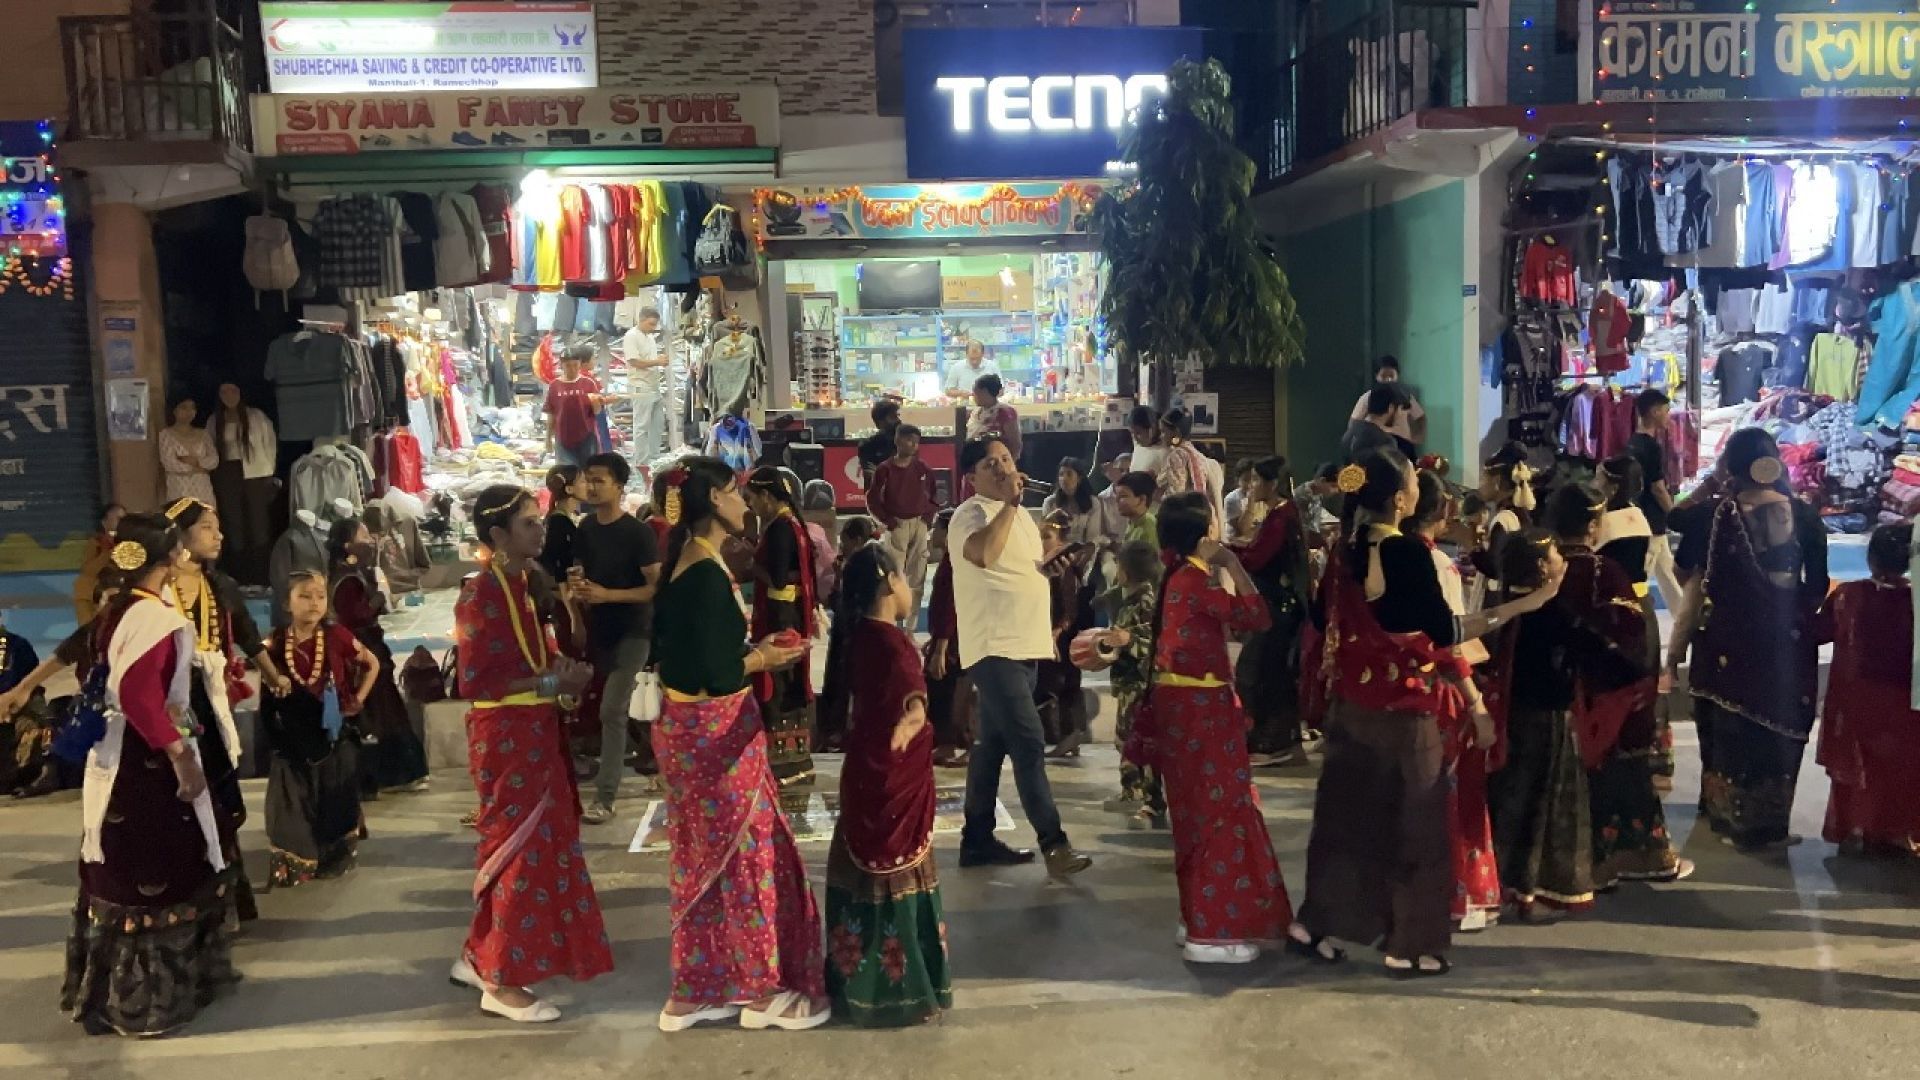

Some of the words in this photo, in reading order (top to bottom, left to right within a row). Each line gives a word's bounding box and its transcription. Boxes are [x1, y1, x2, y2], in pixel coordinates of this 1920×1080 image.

[1599, 13, 1760, 78] कामना
[273, 59, 359, 77] SHUBHECHHA
[362, 58, 408, 75] SAVING
[411, 58, 420, 74] &
[424, 57, 467, 74] CREDIT
[470, 56, 557, 74] CO-OPERATIVE
[560, 56, 586, 73] LTD.
[284, 97, 435, 131] SIYANA
[457, 96, 586, 128] FANCY
[609, 92, 742, 125] STORE
